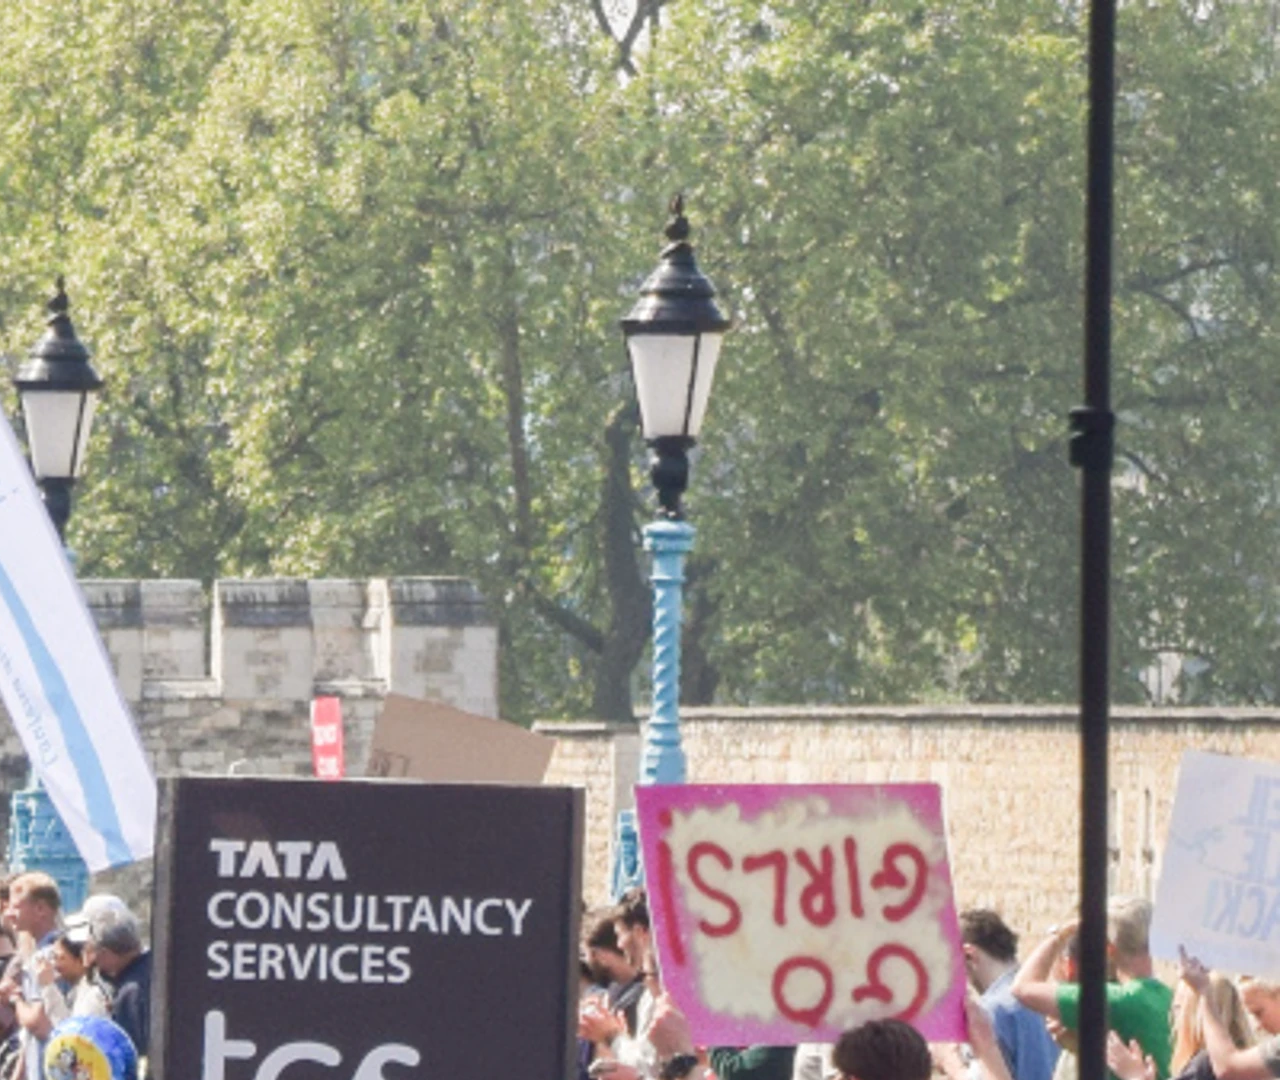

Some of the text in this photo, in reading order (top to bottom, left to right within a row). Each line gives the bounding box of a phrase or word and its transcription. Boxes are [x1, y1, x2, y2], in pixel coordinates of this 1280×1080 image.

[209, 838, 348, 881] TATA
[207, 889, 533, 936] CONSULTANCY
[207, 940, 412, 984] SERVICES
[771, 943, 930, 1028] GO
